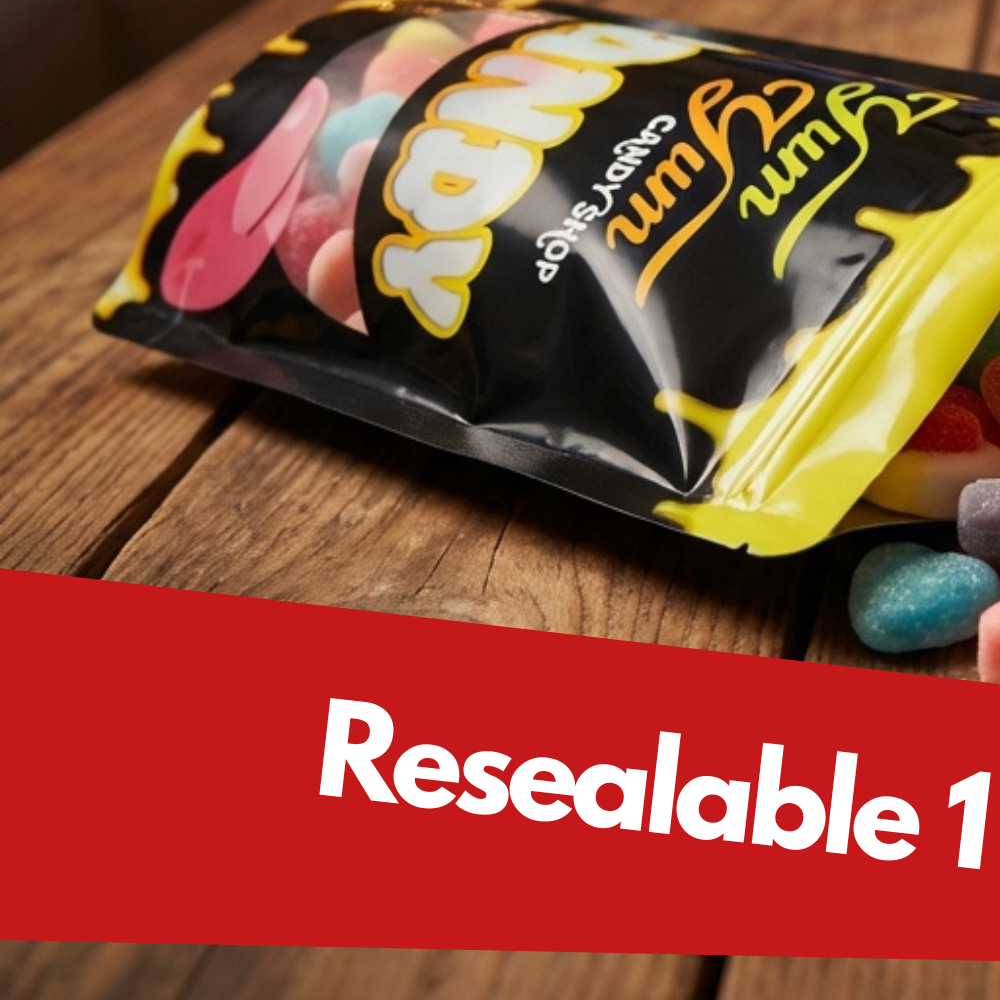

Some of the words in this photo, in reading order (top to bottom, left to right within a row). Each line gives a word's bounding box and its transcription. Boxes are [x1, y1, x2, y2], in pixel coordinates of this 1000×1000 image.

[372, 21, 703, 339] ANDY
[535, 200, 599, 284] SHOP
[591, 114, 677, 217] CANDY
[606, 77, 815, 309] Yum
[738, 81, 960, 281] Yum
